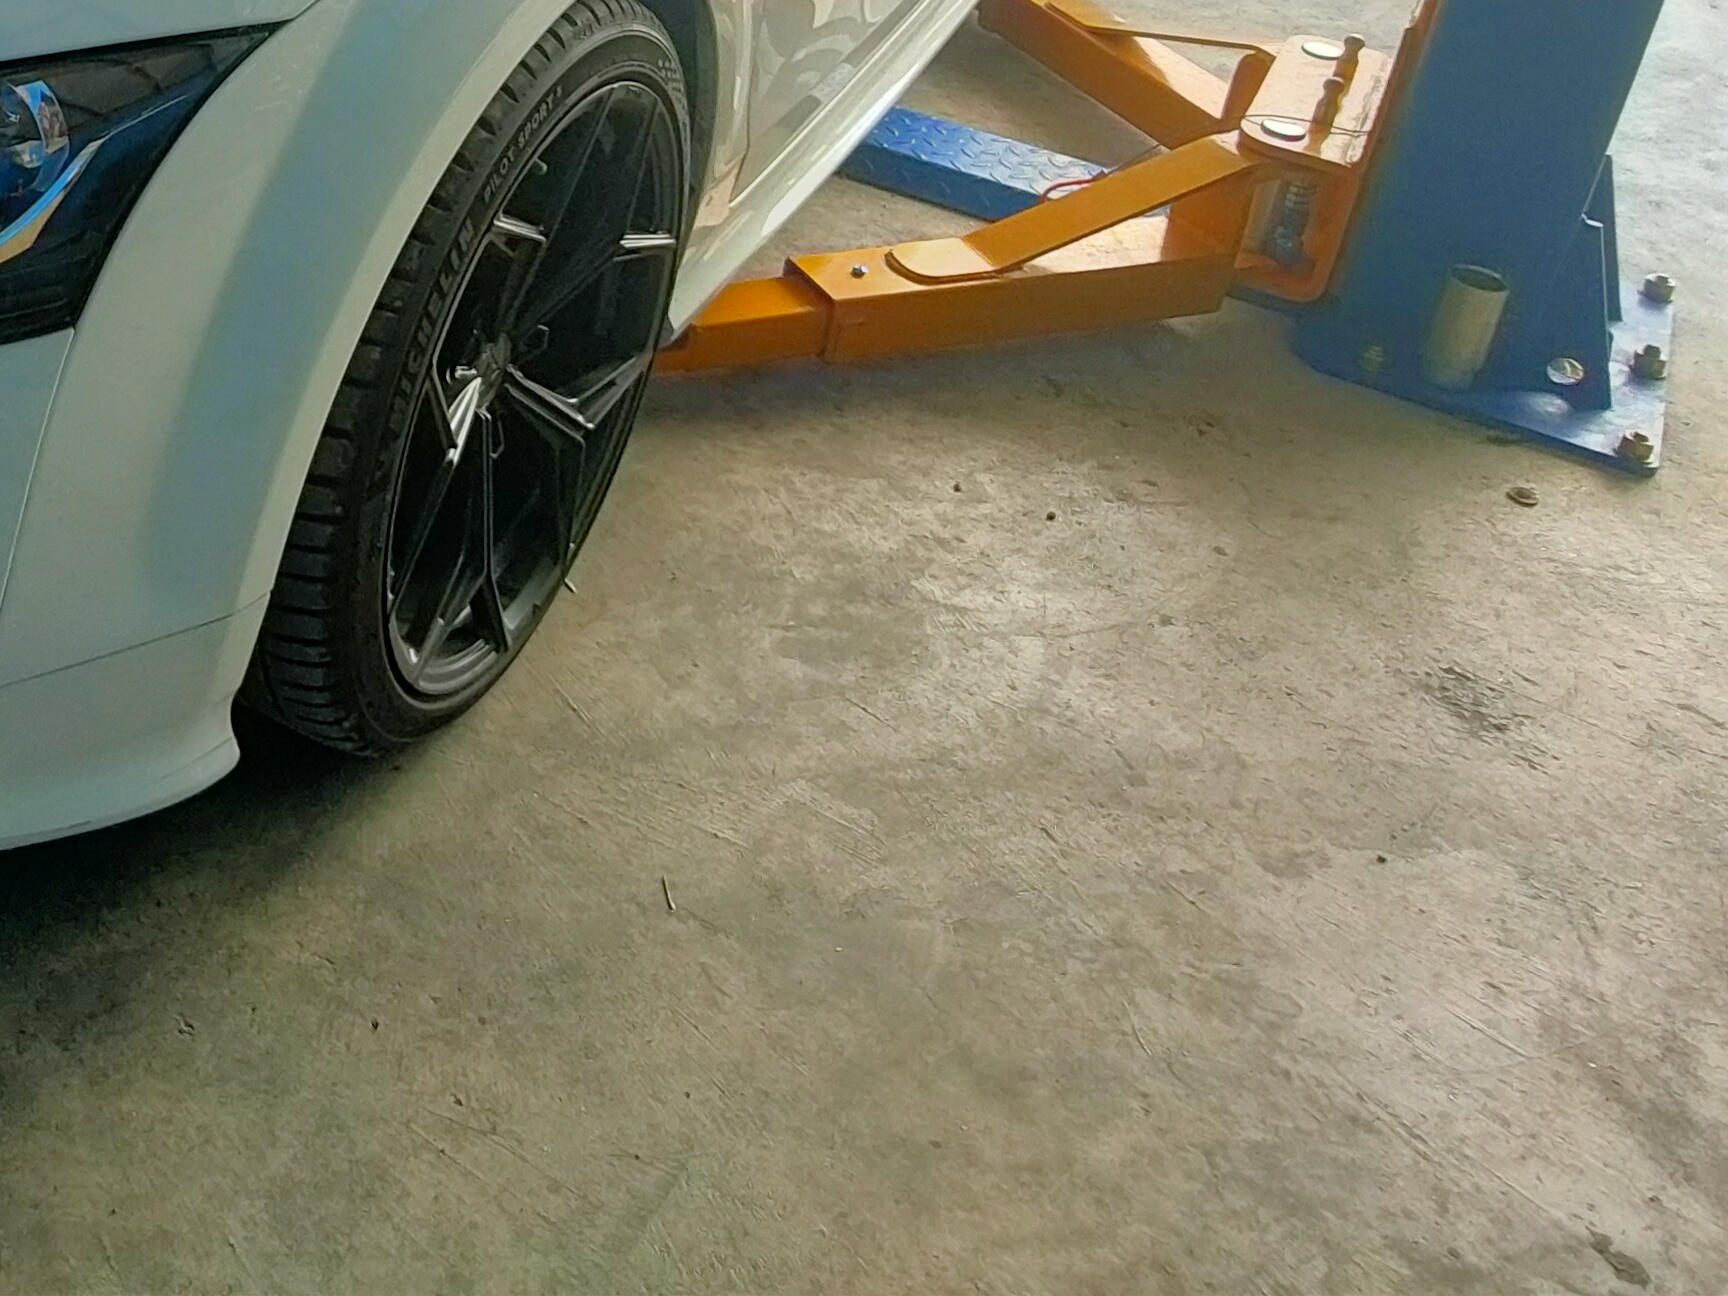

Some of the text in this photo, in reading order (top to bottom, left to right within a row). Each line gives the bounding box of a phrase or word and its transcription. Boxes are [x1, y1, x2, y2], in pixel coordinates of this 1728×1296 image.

[483, 145, 516, 204] PILOT
[517, 92, 555, 150] SPORT
[388, 217, 475, 435] MICHELIN
